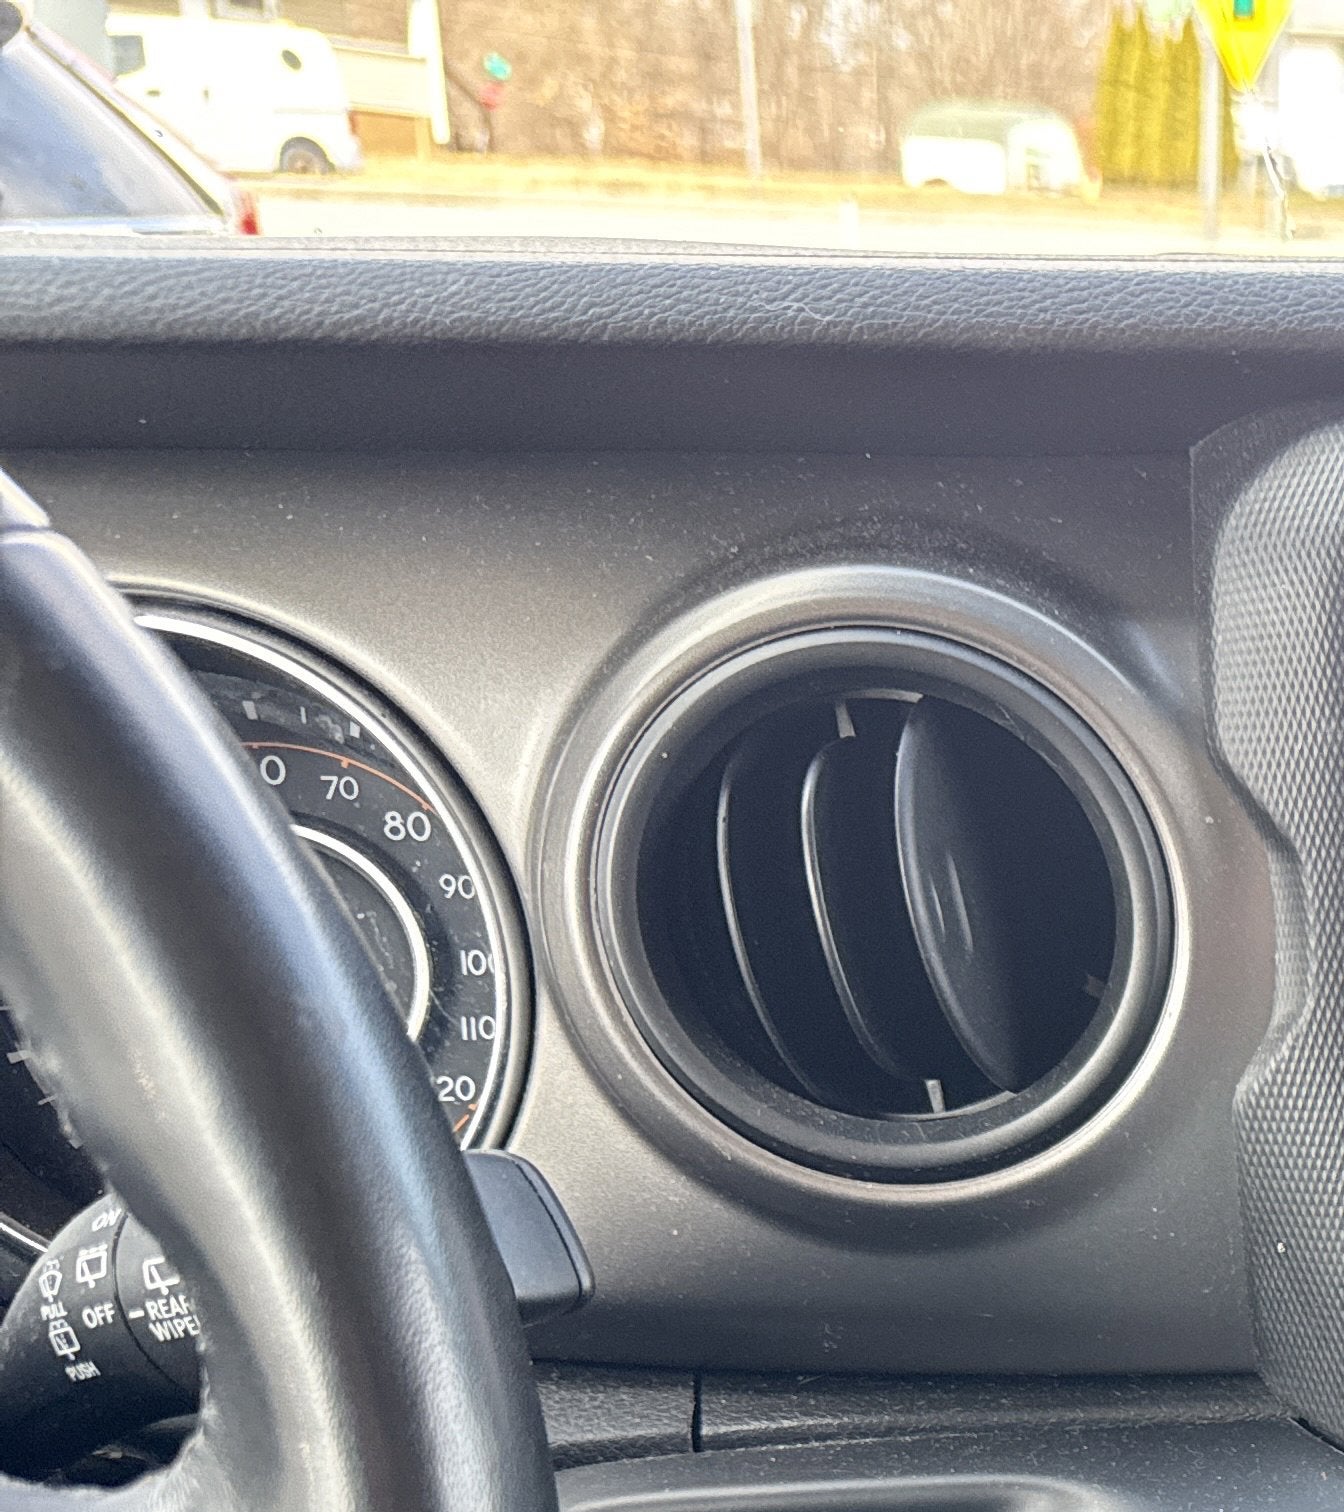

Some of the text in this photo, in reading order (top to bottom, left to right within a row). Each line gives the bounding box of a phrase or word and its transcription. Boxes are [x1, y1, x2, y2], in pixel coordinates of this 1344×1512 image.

[320, 776, 359, 801] 70
[384, 811, 431, 842] 80
[439, 874, 475, 900] 90
[461, 1016, 495, 1041] 110
[91, 1208, 122, 1232] ON
[40, 1301, 67, 1321] PULL
[82, 1303, 115, 1329] OFF
[64, 1360, 101, 1382] PUSH
